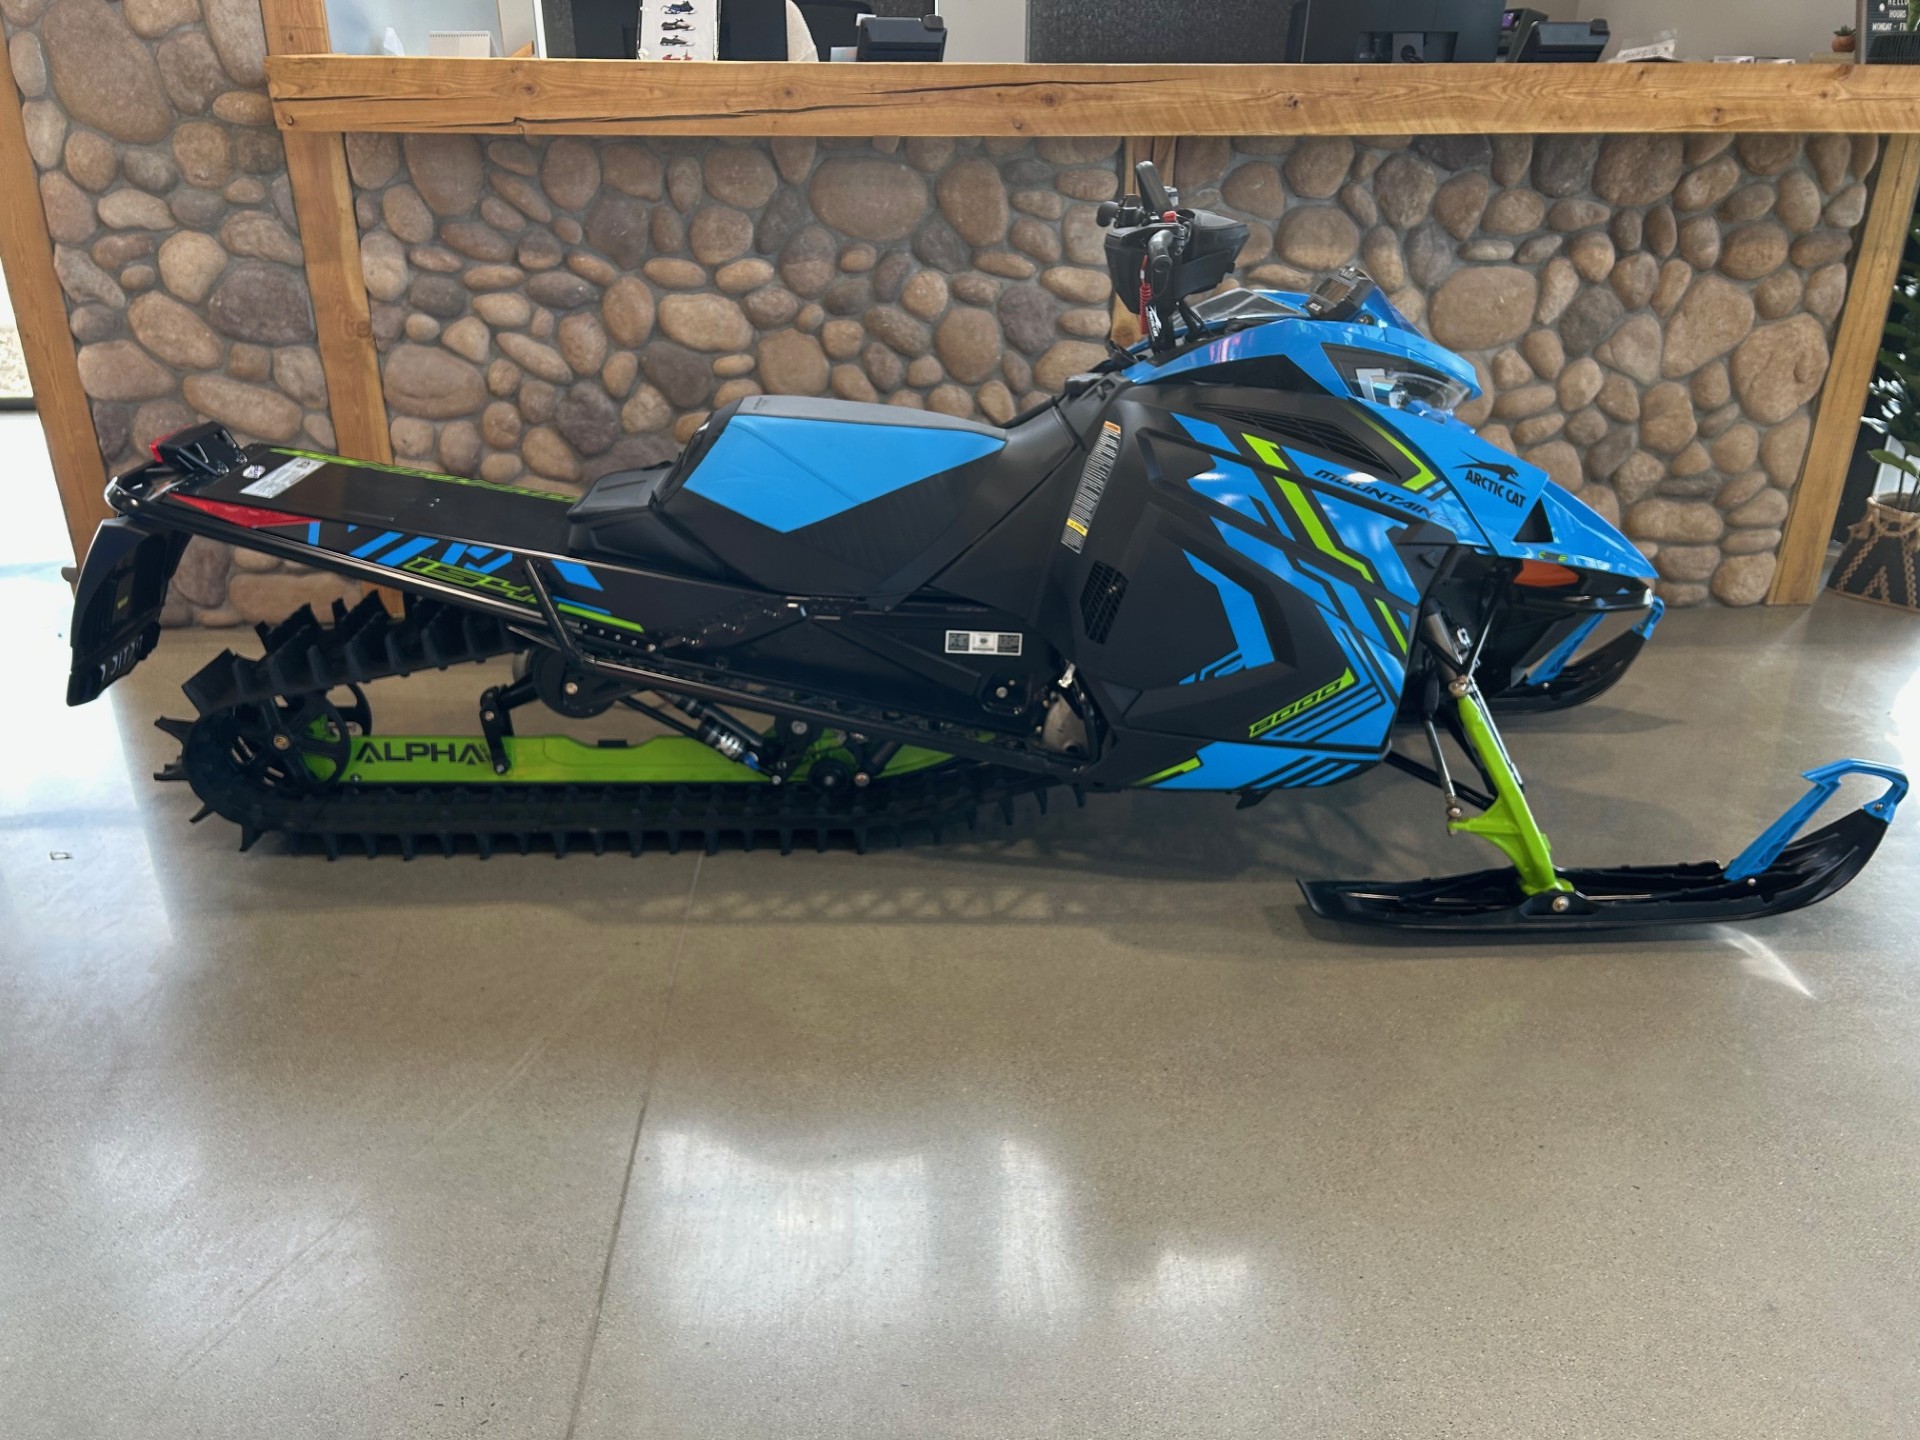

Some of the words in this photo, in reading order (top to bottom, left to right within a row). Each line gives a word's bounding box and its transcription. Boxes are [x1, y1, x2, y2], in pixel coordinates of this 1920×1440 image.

[1889, 10, 1906, 18] HOURS
[1872, 22, 1892, 31] MONDAY
[1314, 469, 1436, 518] MOUNTAIN
[1465, 469, 1504, 498] ARCTIC
[1505, 488, 1527, 508] CAT
[355, 741, 487, 765] ALPHA
